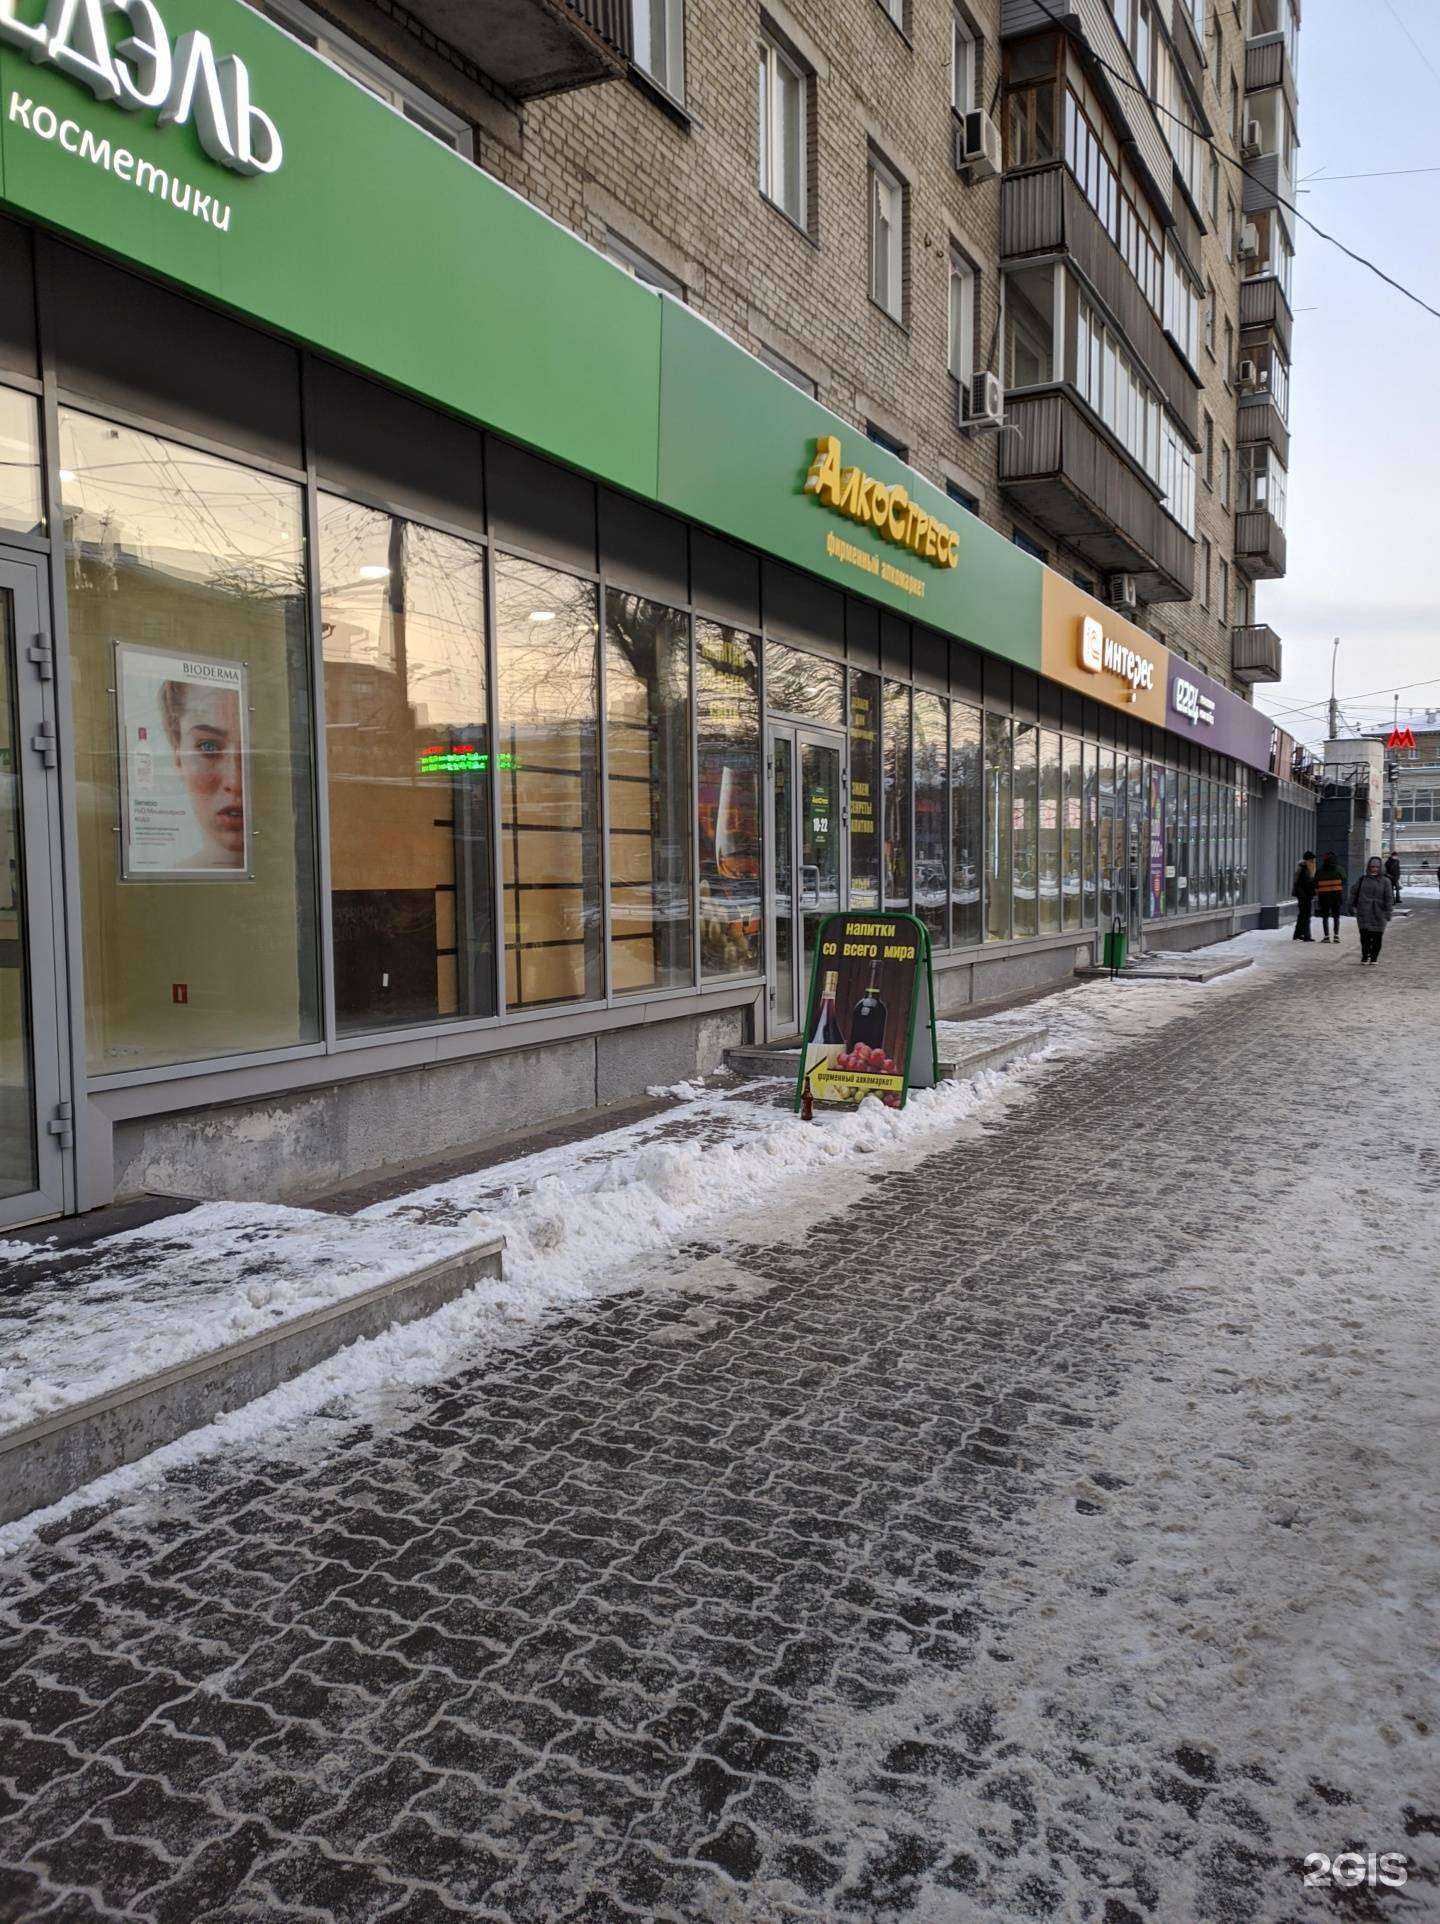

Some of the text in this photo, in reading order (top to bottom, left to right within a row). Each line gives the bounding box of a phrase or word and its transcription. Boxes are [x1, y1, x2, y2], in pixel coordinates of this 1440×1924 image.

[0, 0, 283, 174] ДЭЛЬ
[8, 91, 231, 232] косметики
[183, 662, 239, 681] BIODERMA
[822, 942, 915, 962] со всего мира
